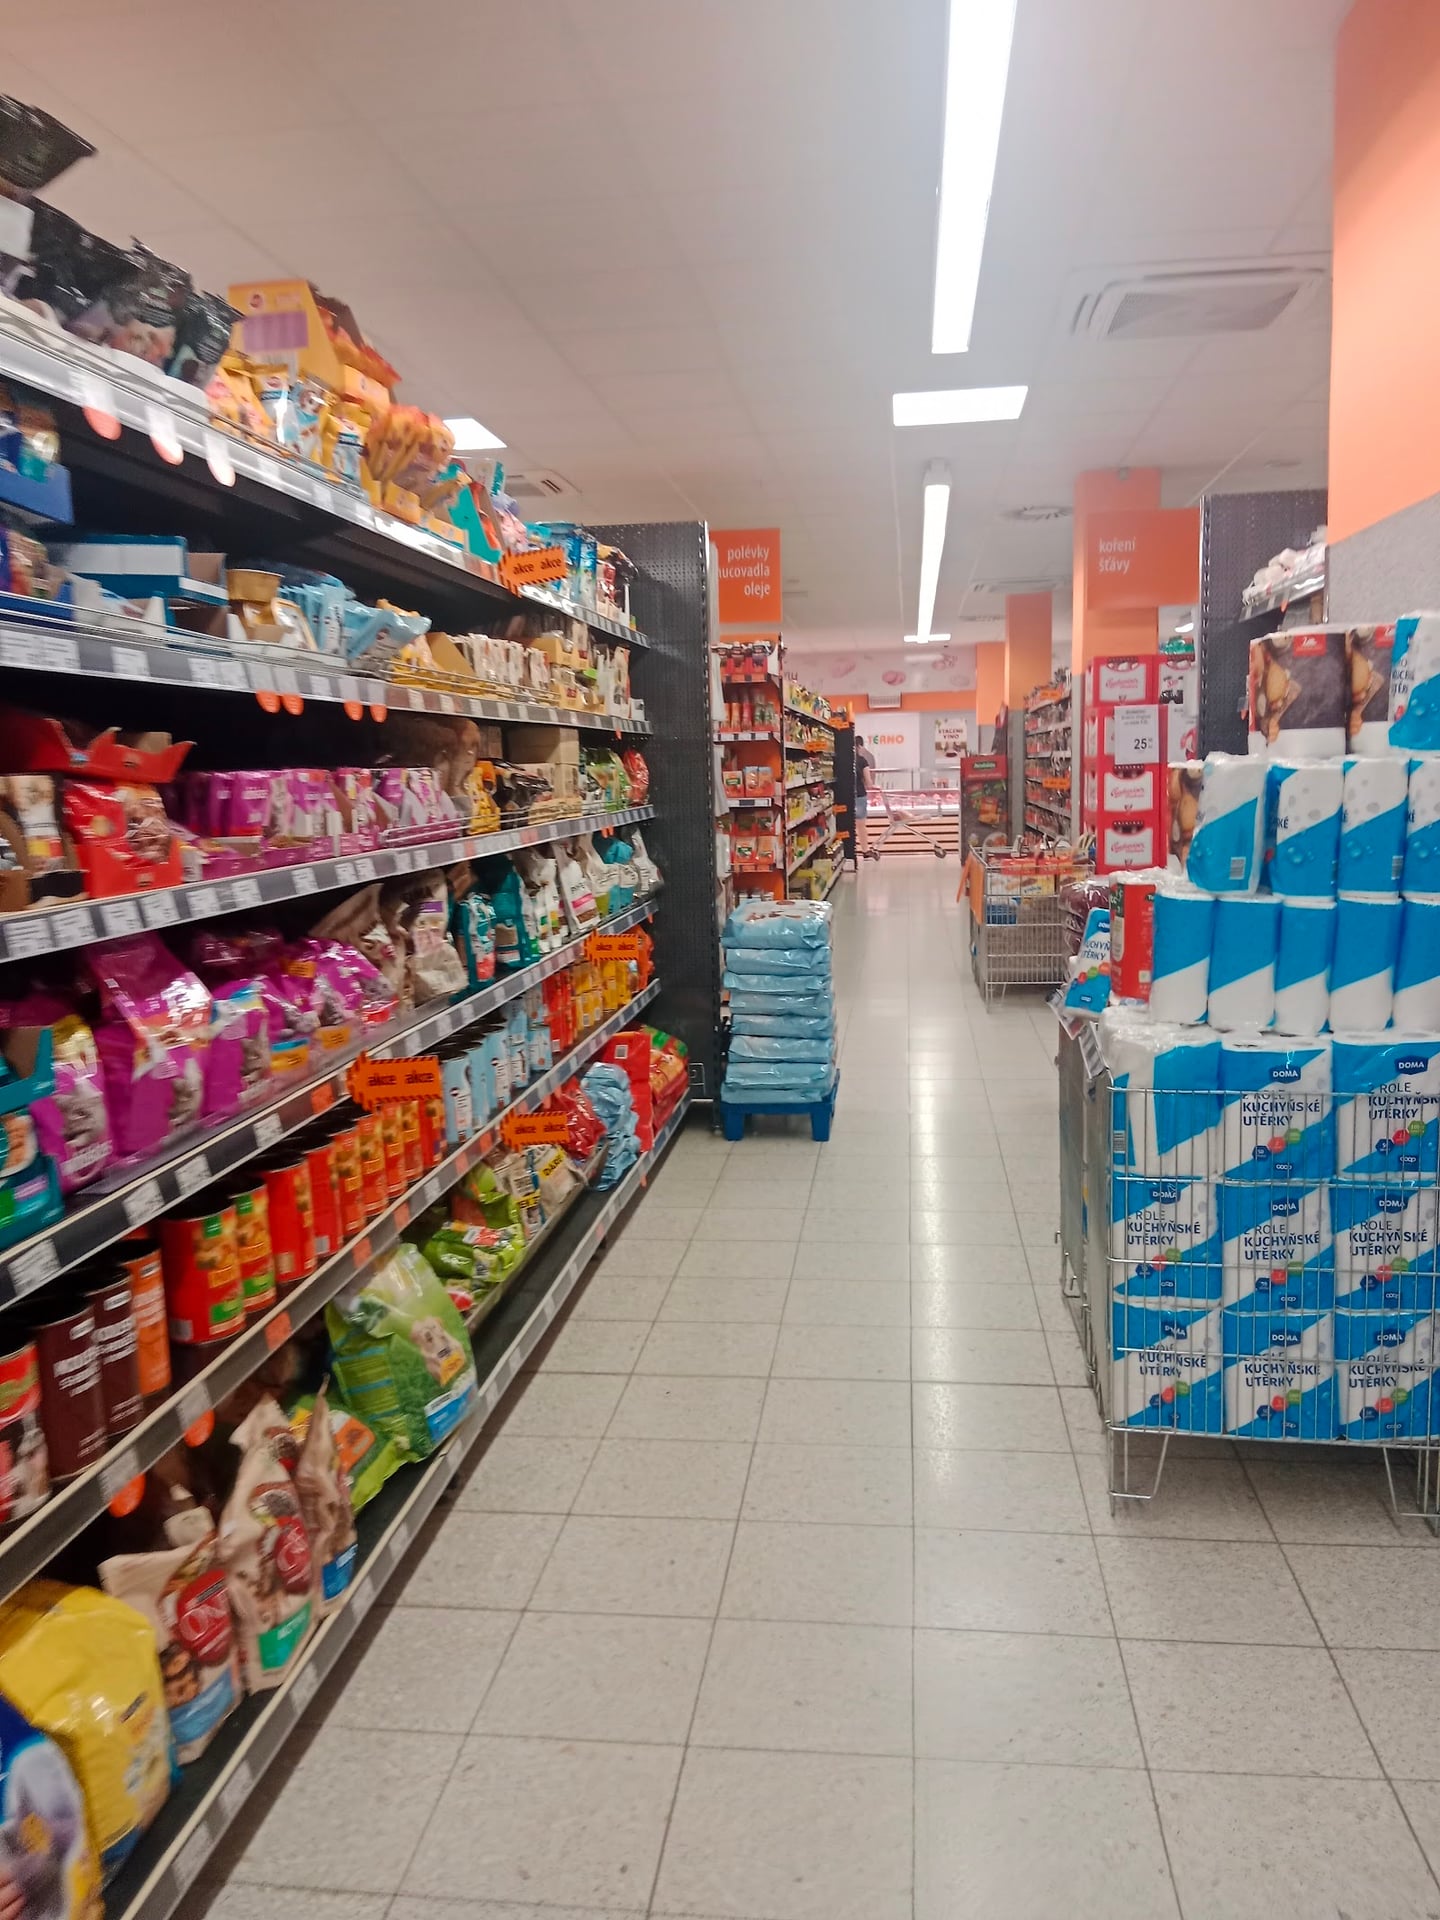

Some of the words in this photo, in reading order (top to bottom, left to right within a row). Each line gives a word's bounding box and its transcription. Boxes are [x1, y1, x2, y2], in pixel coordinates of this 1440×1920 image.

[1099, 537, 1137, 552] koření
[727, 544, 770, 563] polévky
[1099, 556, 1130, 575] šťávy
[744, 581, 771, 600] oleje
[867, 735, 905, 745] TERNO
[1134, 738, 1148, 750] 25
[1398, 1061, 1425, 1070] DOMA
[1272, 1070, 1299, 1078] DOMA
[1380, 1082, 1412, 1094] ROLE
[1243, 1098, 1321, 1113] KUCHYŇSKÉ
[1368, 1090, 1440, 1107] KUCHYŇSK
[1243, 1112, 1293, 1127] UTĚRKY
[1369, 1107, 1419, 1120] UTĚRKY
[1378, 1200, 1406, 1208] DOMA
[1128, 1220, 1201, 1235] KUCHYŇSKÉ
[1256, 1224, 1286, 1234] ROLE
[1361, 1220, 1393, 1231] ROLE
[1244, 1231, 1321, 1247] KUCHYŇSKÉ
[1350, 1228, 1428, 1243] KUCHYŇSKÉ
[1245, 1247, 1295, 1261] UTĚRKY
[1376, 1333, 1403, 1341] DOMA
[1349, 1375, 1397, 1389] UTĚRKY
